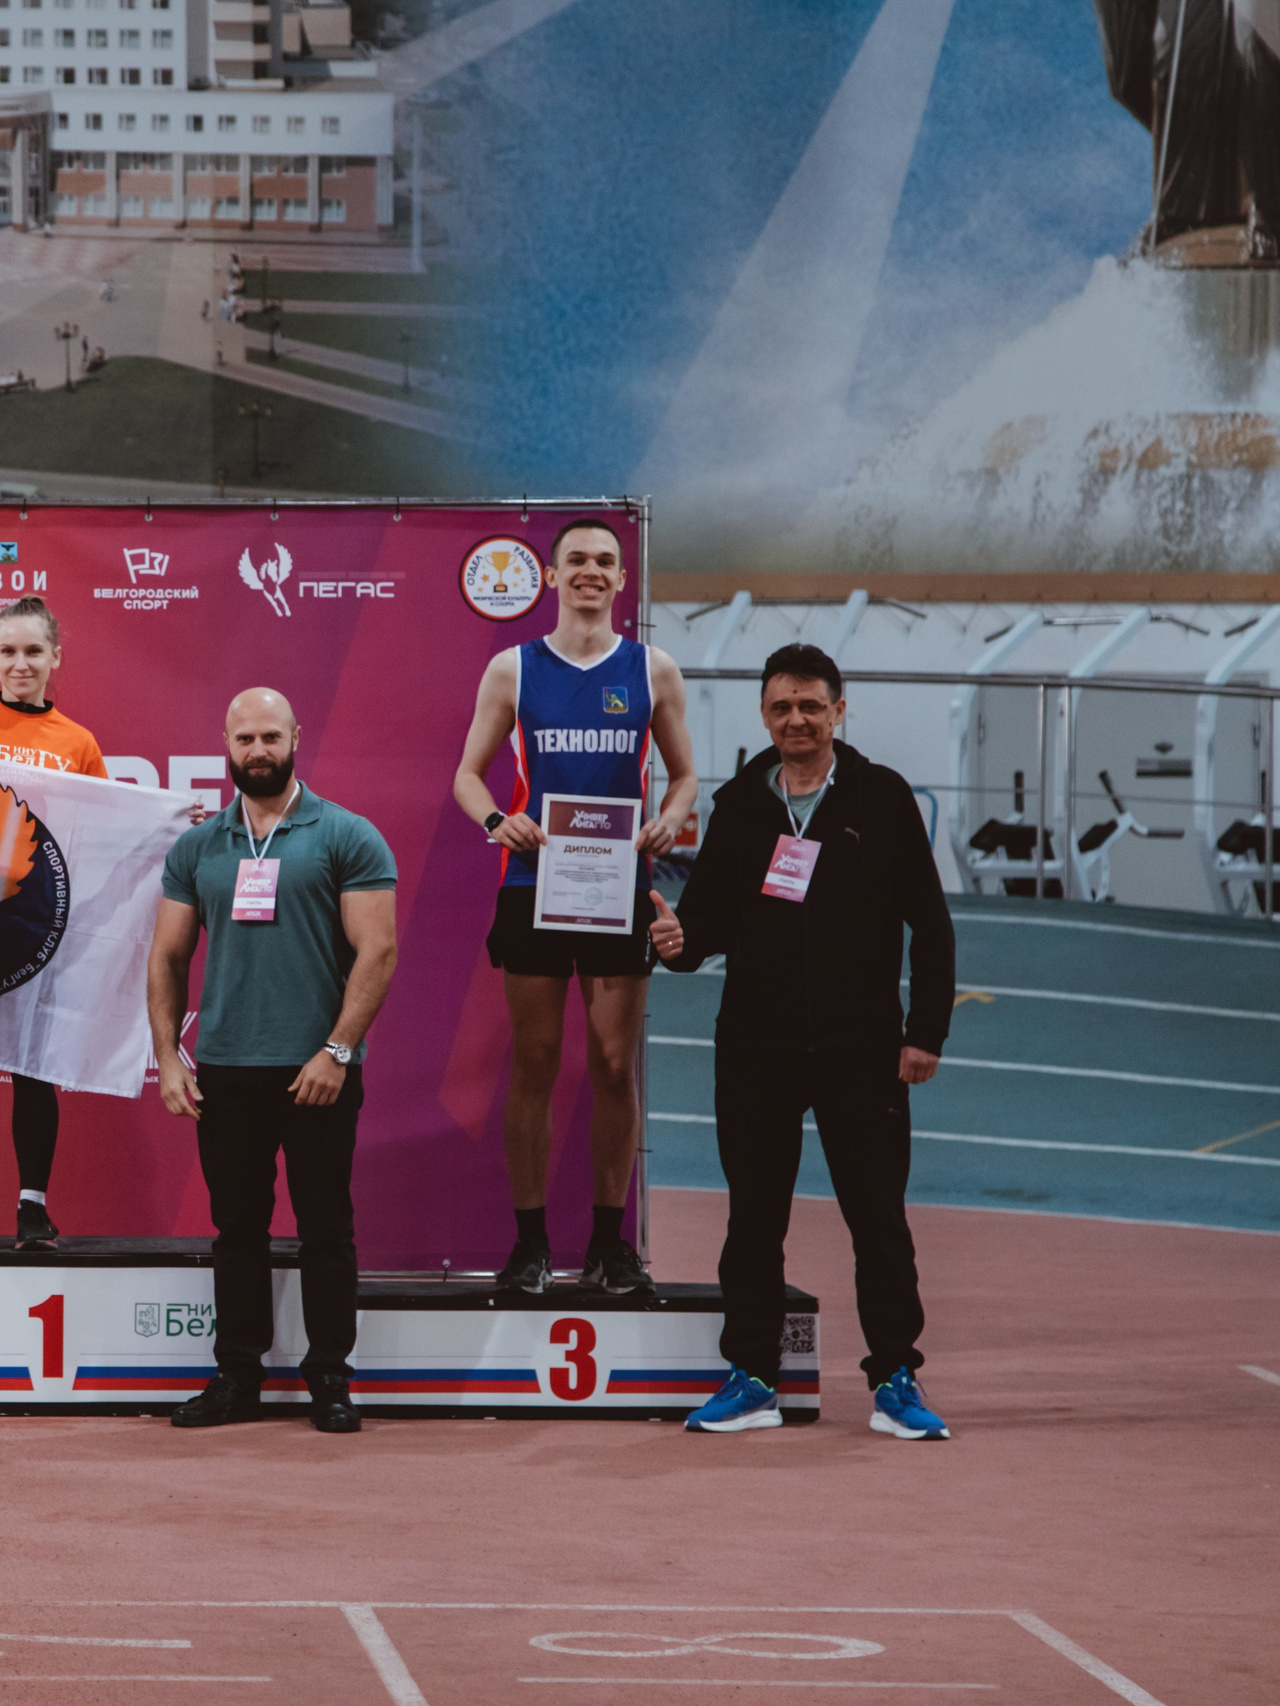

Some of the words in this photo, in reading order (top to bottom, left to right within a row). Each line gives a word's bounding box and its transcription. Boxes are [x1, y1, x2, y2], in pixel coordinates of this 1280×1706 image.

[467, 554, 484, 586] ОТДЕЛ
[513, 546, 539, 588] РАЗВИТИЯ
[93, 586, 199, 599] БЕЛГОРОДСКИЙ
[299, 582, 395, 598] ПЕГАС
[123, 600, 169, 610] СПОРТ
[13, 746, 38, 757] НИУ
[534, 728, 638, 754] ТЕХНОЛОГ
[563, 844, 613, 855] ДИПЛОМ
[42, 841, 67, 930] СПОРТИВНЫЙ
[36, 930, 59, 962] КЛУБ
[166, 1308, 217, 1337] Бел
[187, 1303, 212, 1317] НИ
[28, 1294, 64, 1378] 1
[549, 1317, 597, 1401] 3
[528, 1628, 887, 1662] 8
